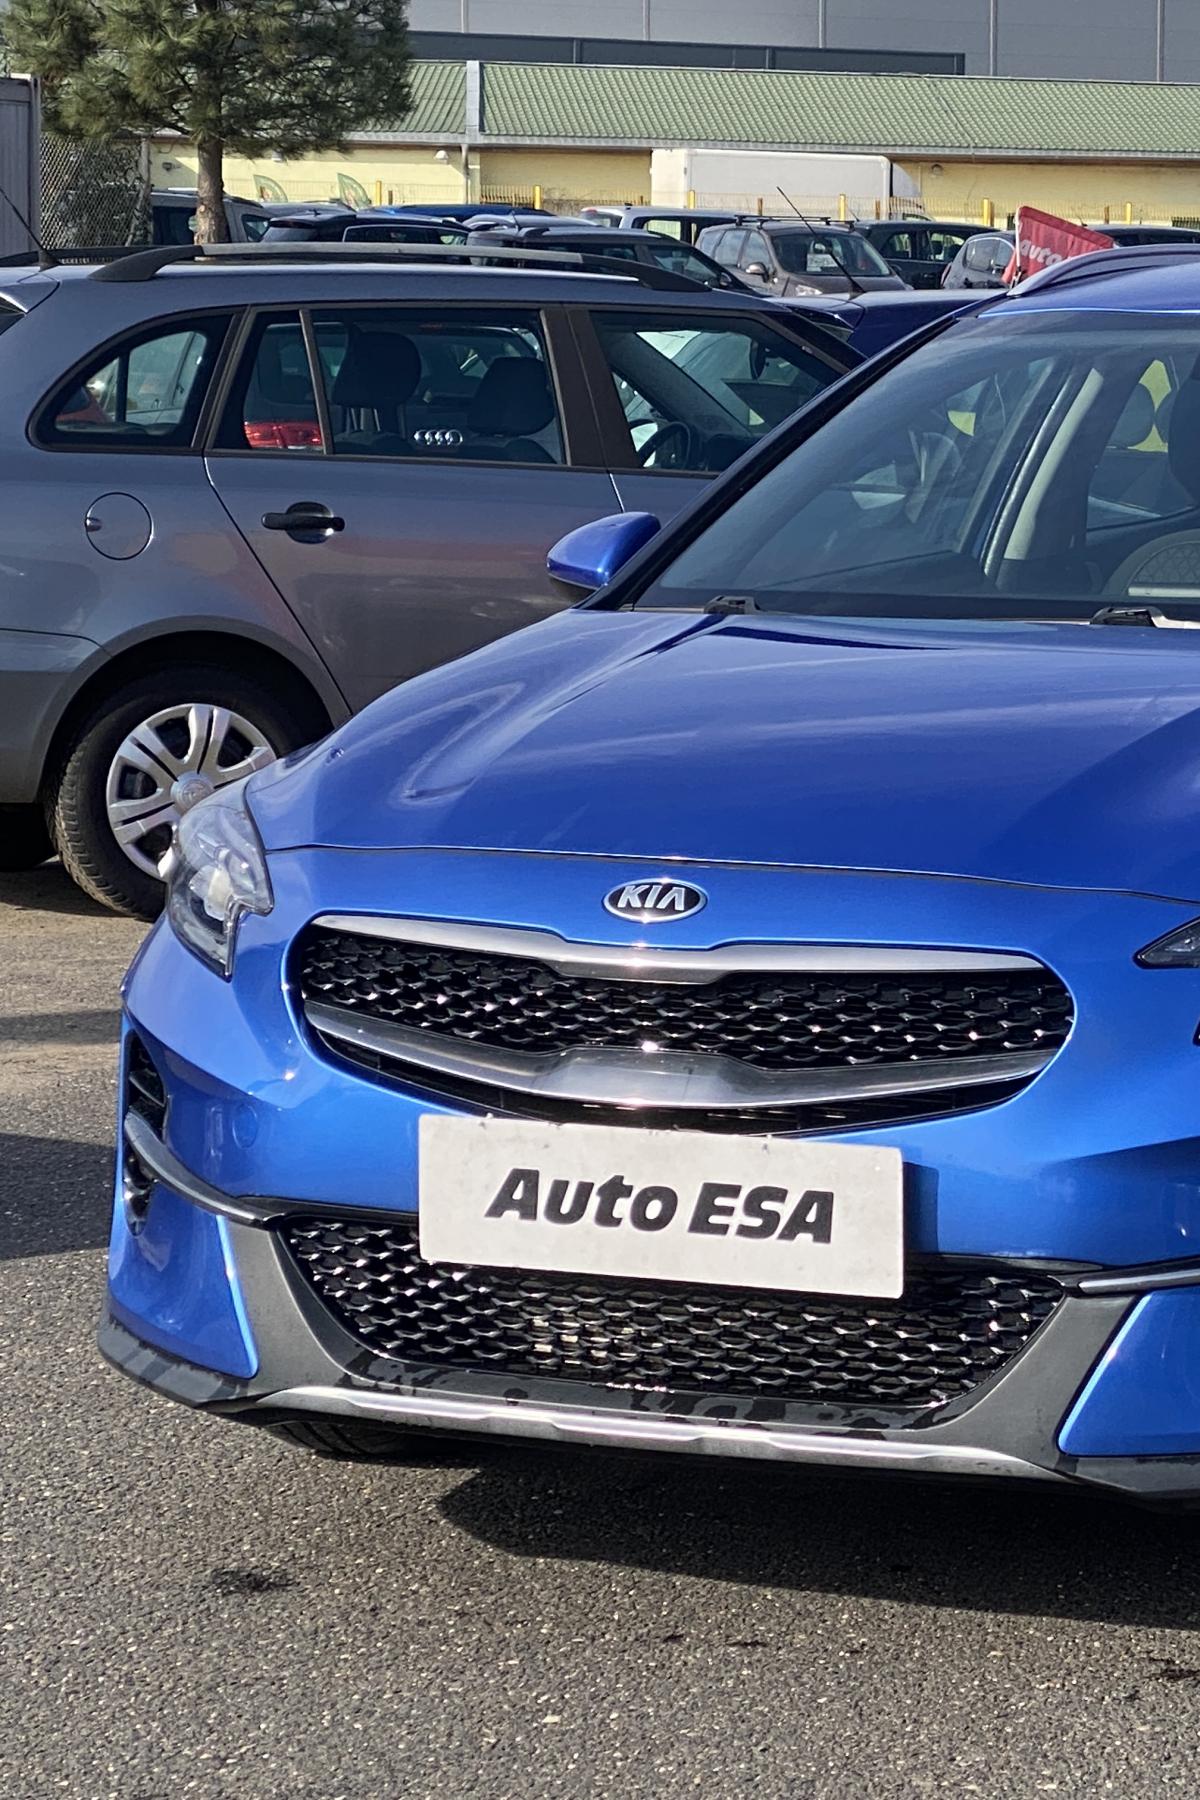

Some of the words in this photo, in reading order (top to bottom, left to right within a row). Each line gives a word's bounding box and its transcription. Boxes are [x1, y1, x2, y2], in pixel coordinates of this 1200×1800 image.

[617, 885, 686, 911] KIA
[486, 1168, 679, 1232] Auto
[688, 1182, 834, 1245] ESA
